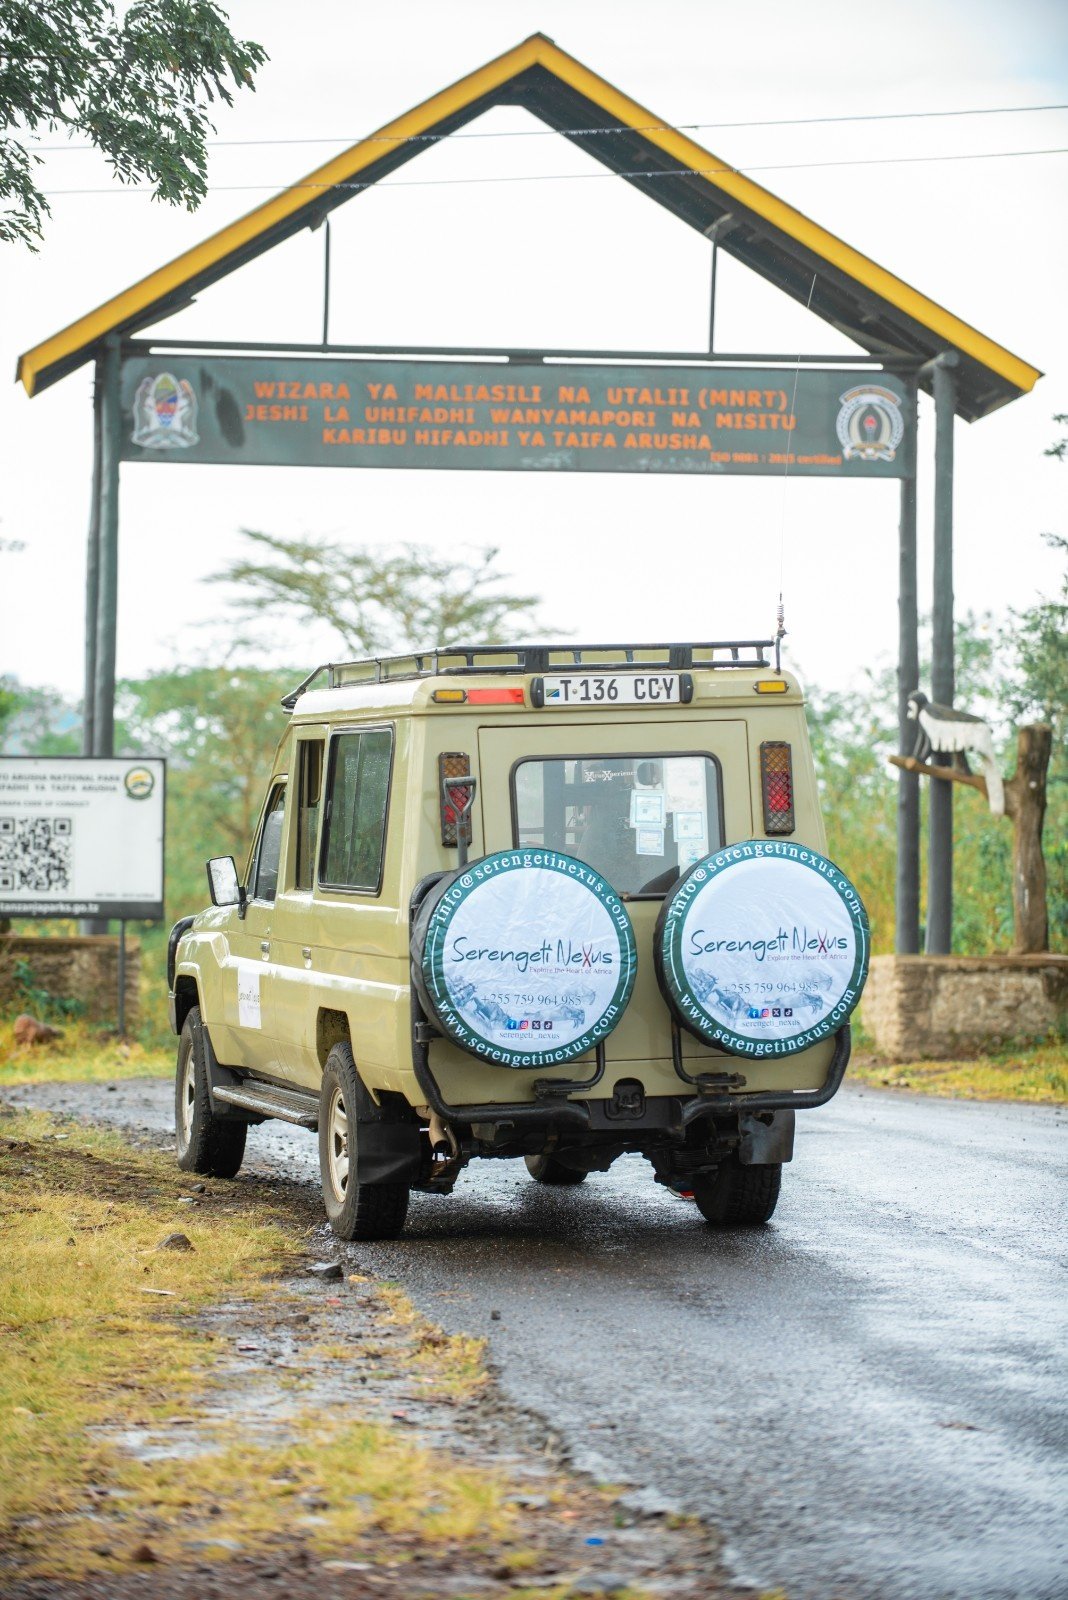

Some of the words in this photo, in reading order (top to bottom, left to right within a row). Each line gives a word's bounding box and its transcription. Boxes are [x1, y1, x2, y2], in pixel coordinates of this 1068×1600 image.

[253, 381, 351, 401] WIZARA
[367, 383, 398, 401] YA
[414, 384, 541, 404] MALIASILI
[557, 386, 591, 404] NA
[607, 387, 689, 407] UTALII
[697, 388, 788, 411] (MNRT)
[245, 404, 309, 423] JESHI
[323, 406, 350, 423] LA
[364, 407, 475, 424] UHIFADHI
[489, 408, 656, 428] WANYAMAPORI
[671, 411, 702, 428] NA
[715, 411, 797, 431] MISITU
[321, 428, 408, 446] KARIBU
[414, 430, 509, 447] HIFADHI
[517, 431, 546, 448] YA
[553, 431, 618, 449] TAIFA
[623, 433, 713, 451] ARUSHA
[559, 679, 572, 702] T
[579, 678, 619, 702] 136
[634, 677, 674, 701] CCY
[433, 853, 629, 931] info@serengetinexus.com
[670, 842, 862, 918] info@serengetinexus.com
[451, 936, 553, 972] Serengeti
[689, 926, 789, 961] Serengeti
[481, 993, 510, 1005] +255
[514, 994, 535, 1005] 759
[561, 995, 582, 1006] 985
[723, 983, 751, 995] +255
[754, 982, 774, 994] 759
[438, 999, 619, 1067] www.serengetinexus.com
[681, 987, 857, 1056] www.serengetinexus.com
